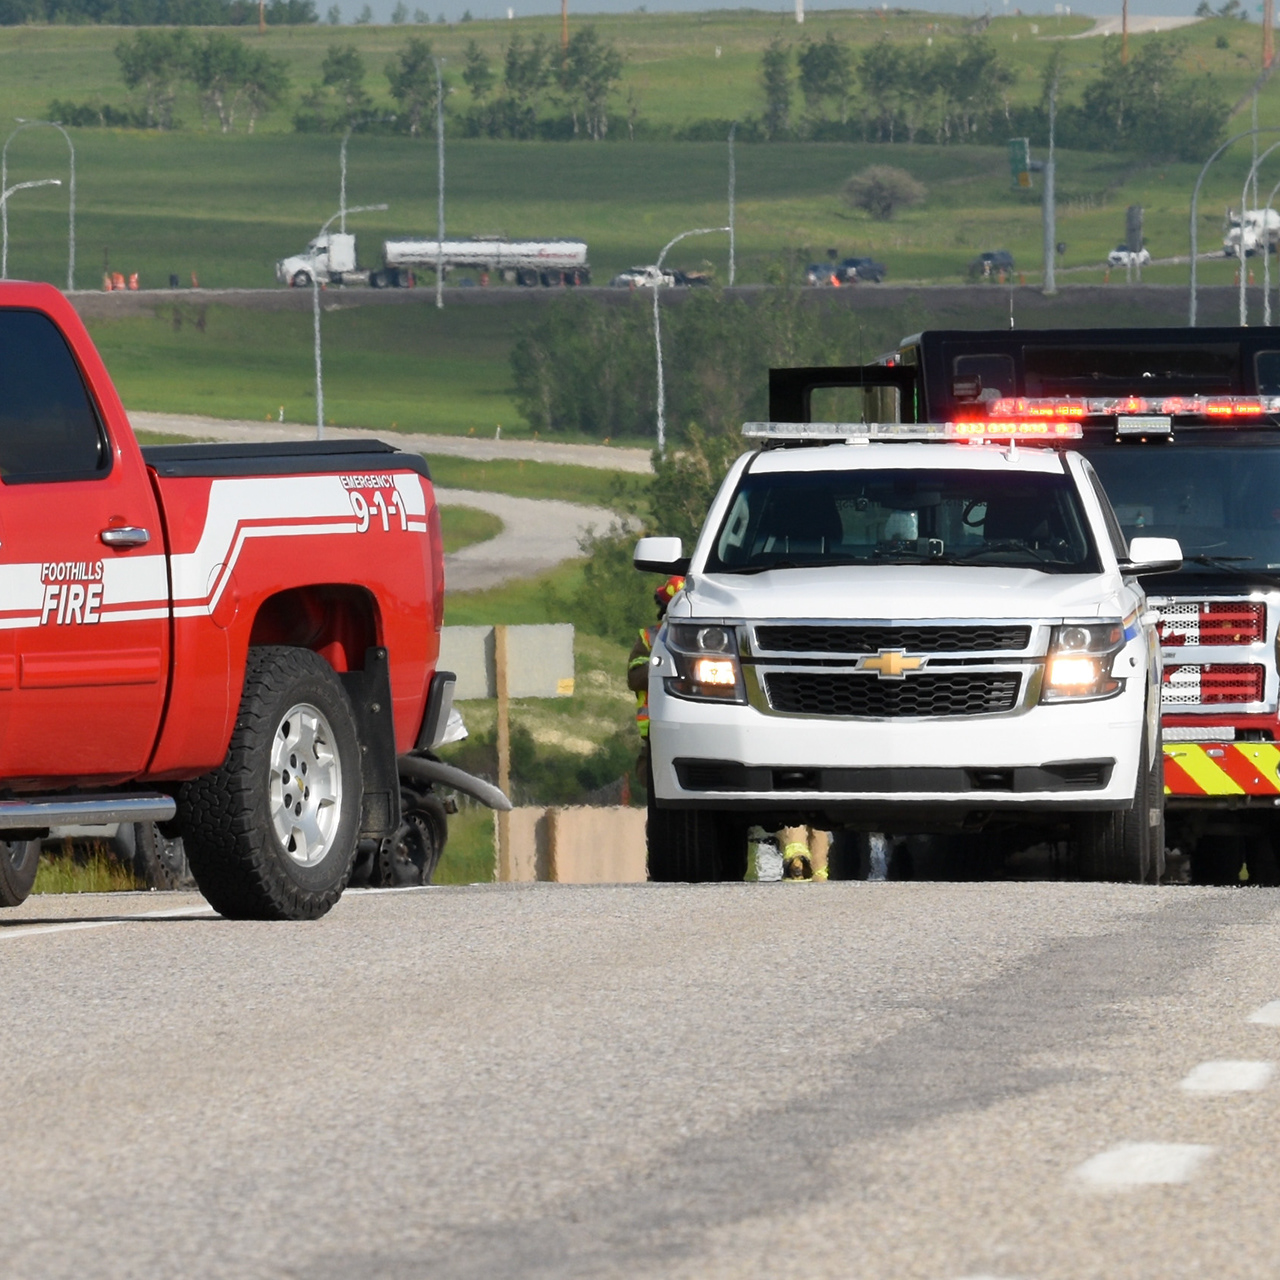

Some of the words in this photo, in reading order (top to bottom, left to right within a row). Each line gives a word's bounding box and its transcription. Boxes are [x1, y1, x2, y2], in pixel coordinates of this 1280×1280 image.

[340, 474, 394, 489] EMERGENCY
[350, 490, 407, 532] 9-1-1
[42, 561, 103, 581] FOOTHILLS
[41, 584, 103, 625] FIRE
